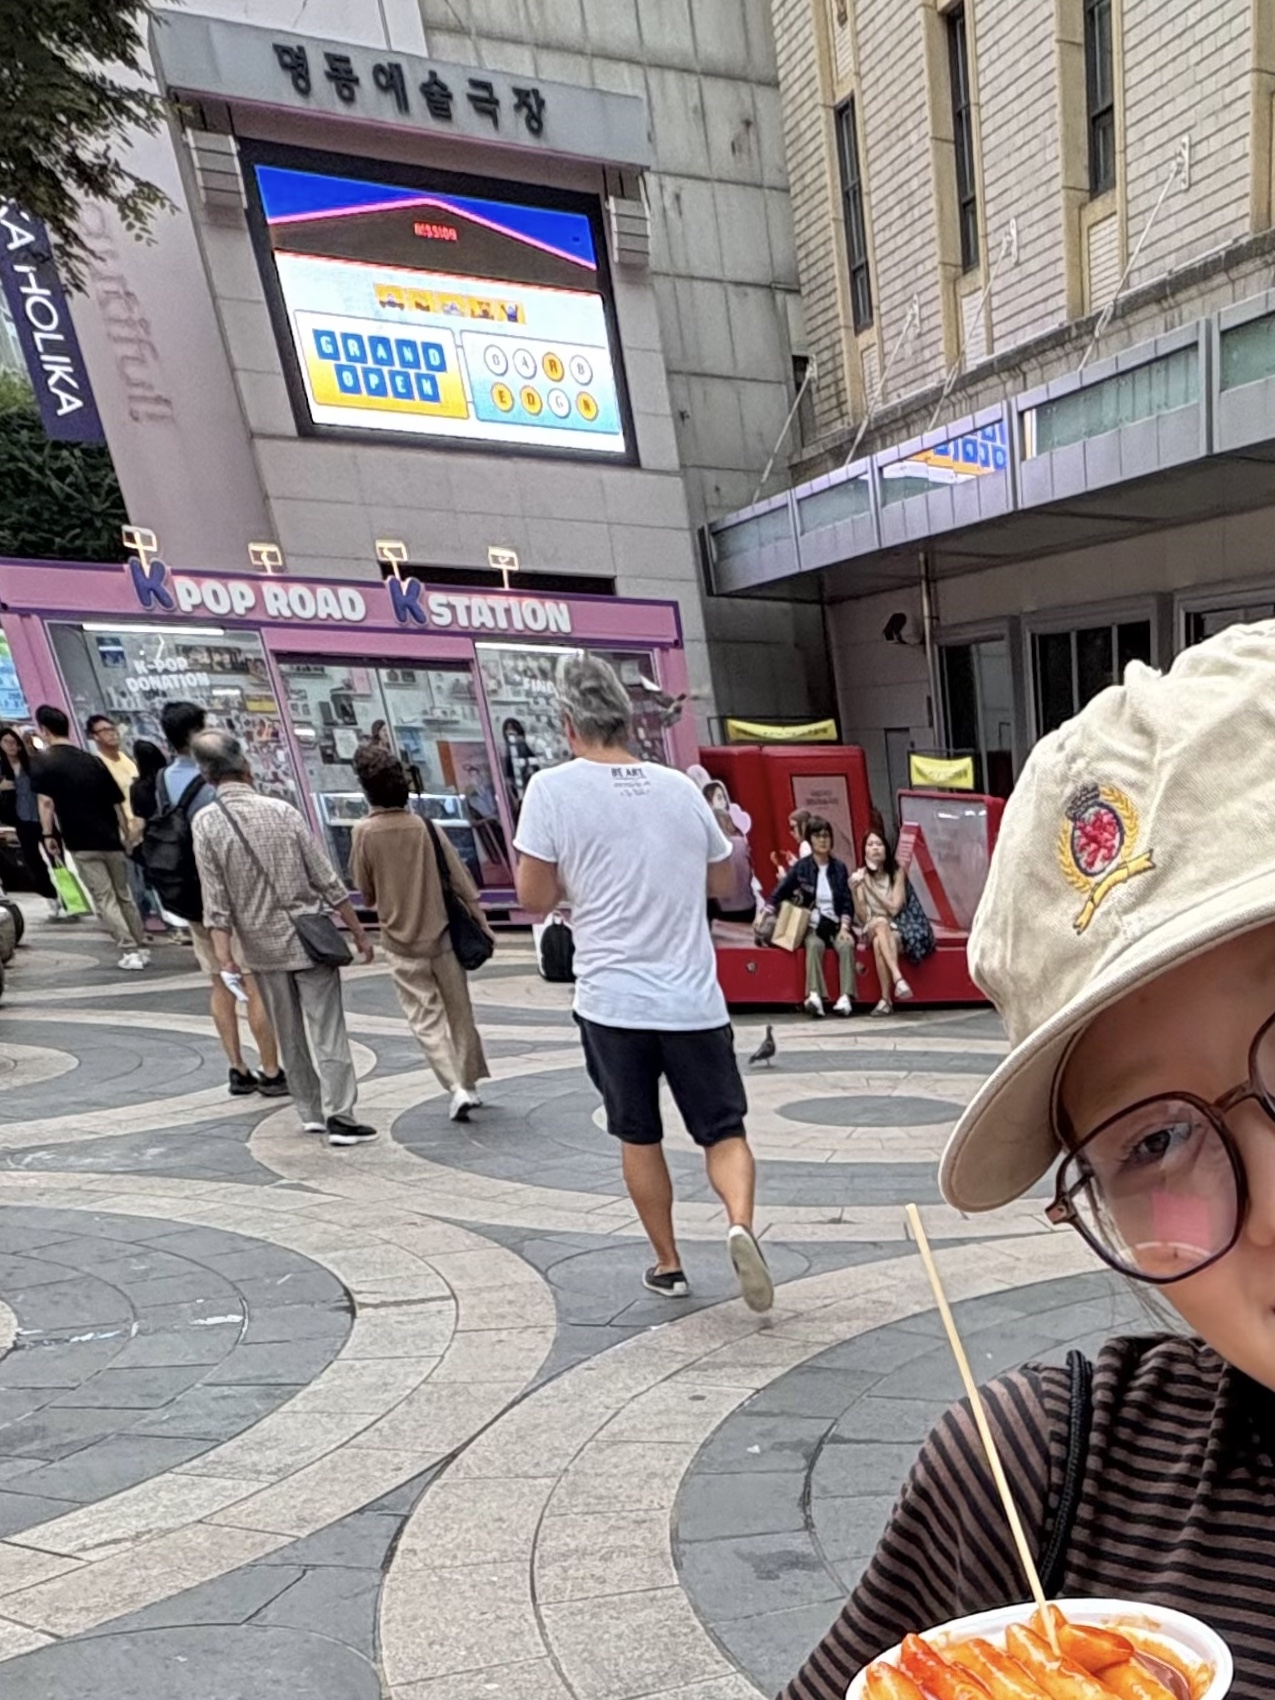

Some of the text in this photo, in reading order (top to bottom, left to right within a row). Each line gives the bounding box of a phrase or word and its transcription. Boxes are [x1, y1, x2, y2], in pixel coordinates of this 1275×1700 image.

[272, 43, 546, 136] 명동예술극장
[13, 264, 84, 417] HOLIKA
[319, 333, 442, 367] GRAND
[341, 369, 435, 397] OPEN
[261, 583, 366, 622] ROAD
[428, 595, 572, 634] STATION
[125, 672, 210, 692] DONATION
